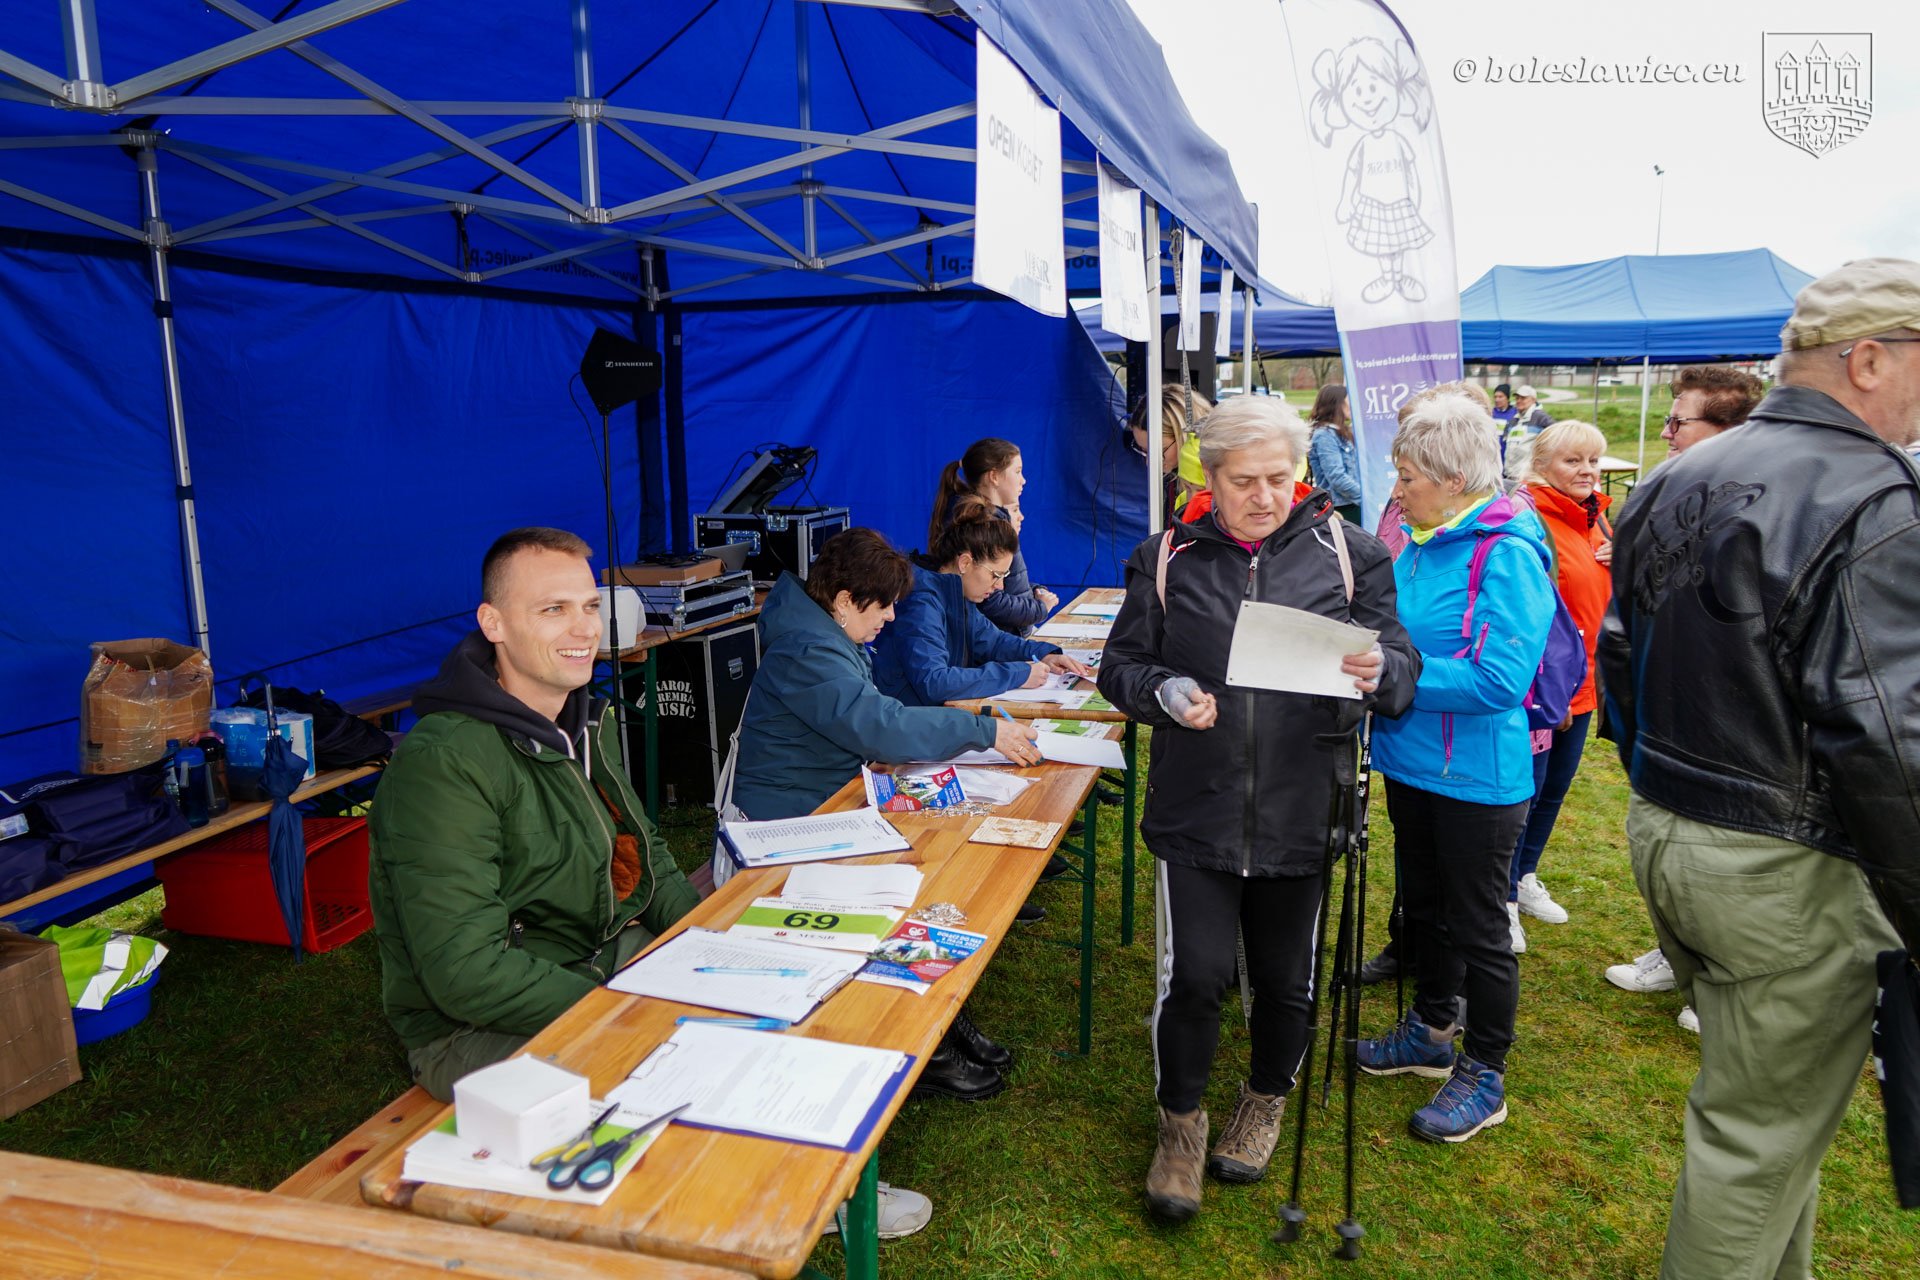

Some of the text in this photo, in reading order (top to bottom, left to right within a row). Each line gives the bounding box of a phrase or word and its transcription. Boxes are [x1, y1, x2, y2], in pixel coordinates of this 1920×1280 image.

[988, 113, 1044, 185] OPEN KOBIET
[656, 691, 694, 704] REMBA
[656, 702, 696, 719] USIC
[783, 912, 840, 930] 69
